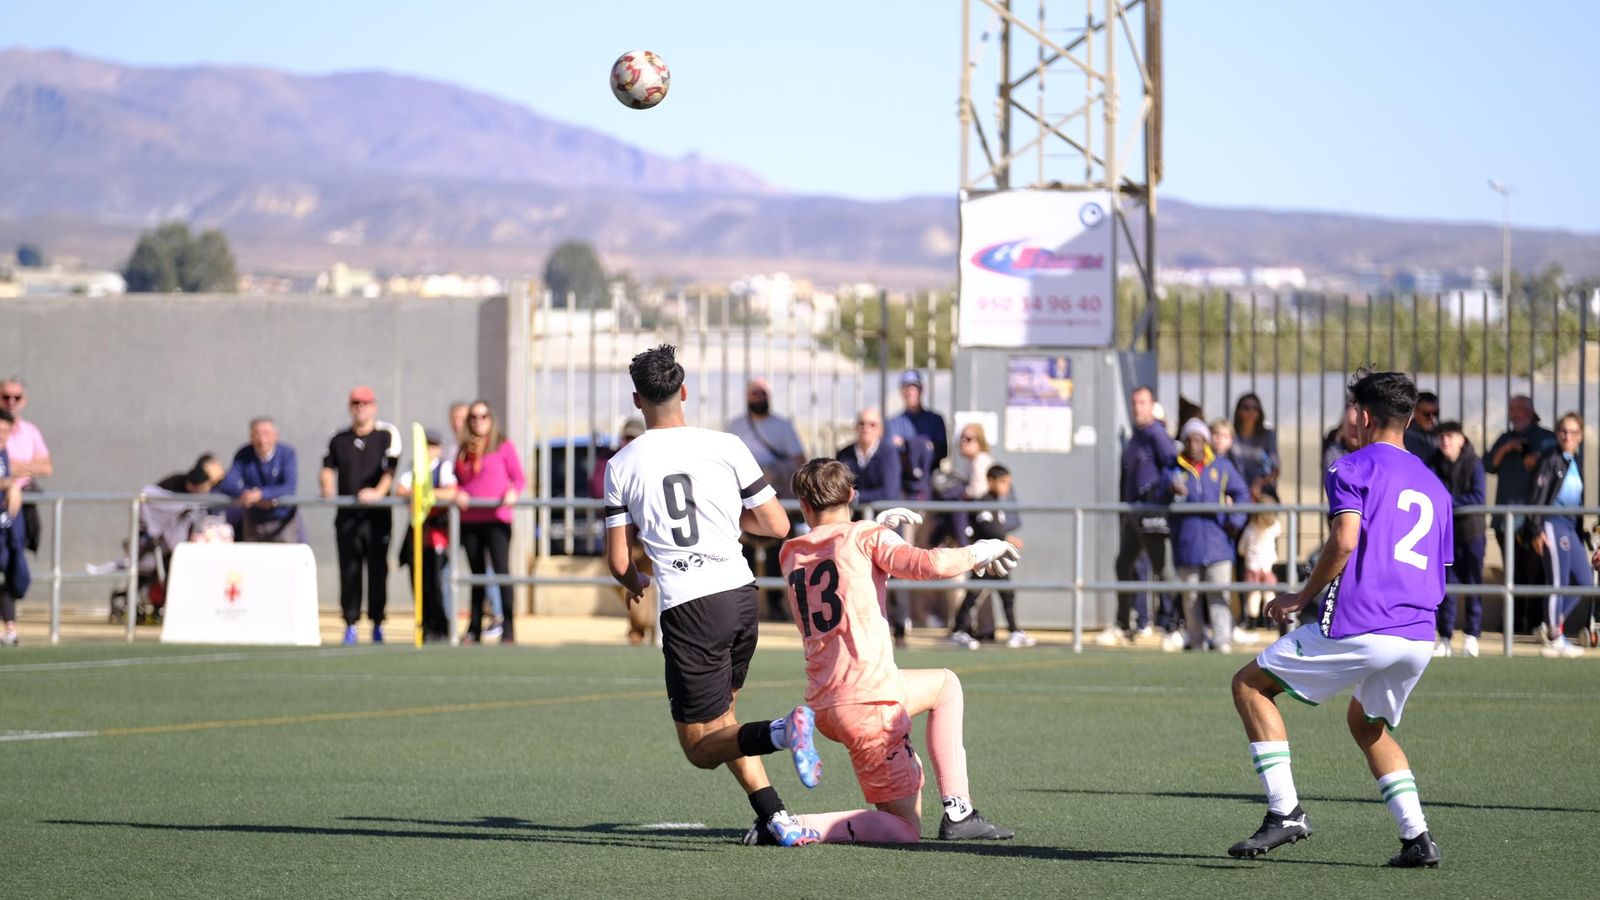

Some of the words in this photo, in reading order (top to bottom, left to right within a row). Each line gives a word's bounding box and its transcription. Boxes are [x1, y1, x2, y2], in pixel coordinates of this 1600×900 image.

[662, 473, 699, 547] 9
[1394, 488, 1434, 571] 2
[788, 558, 842, 638] 13
